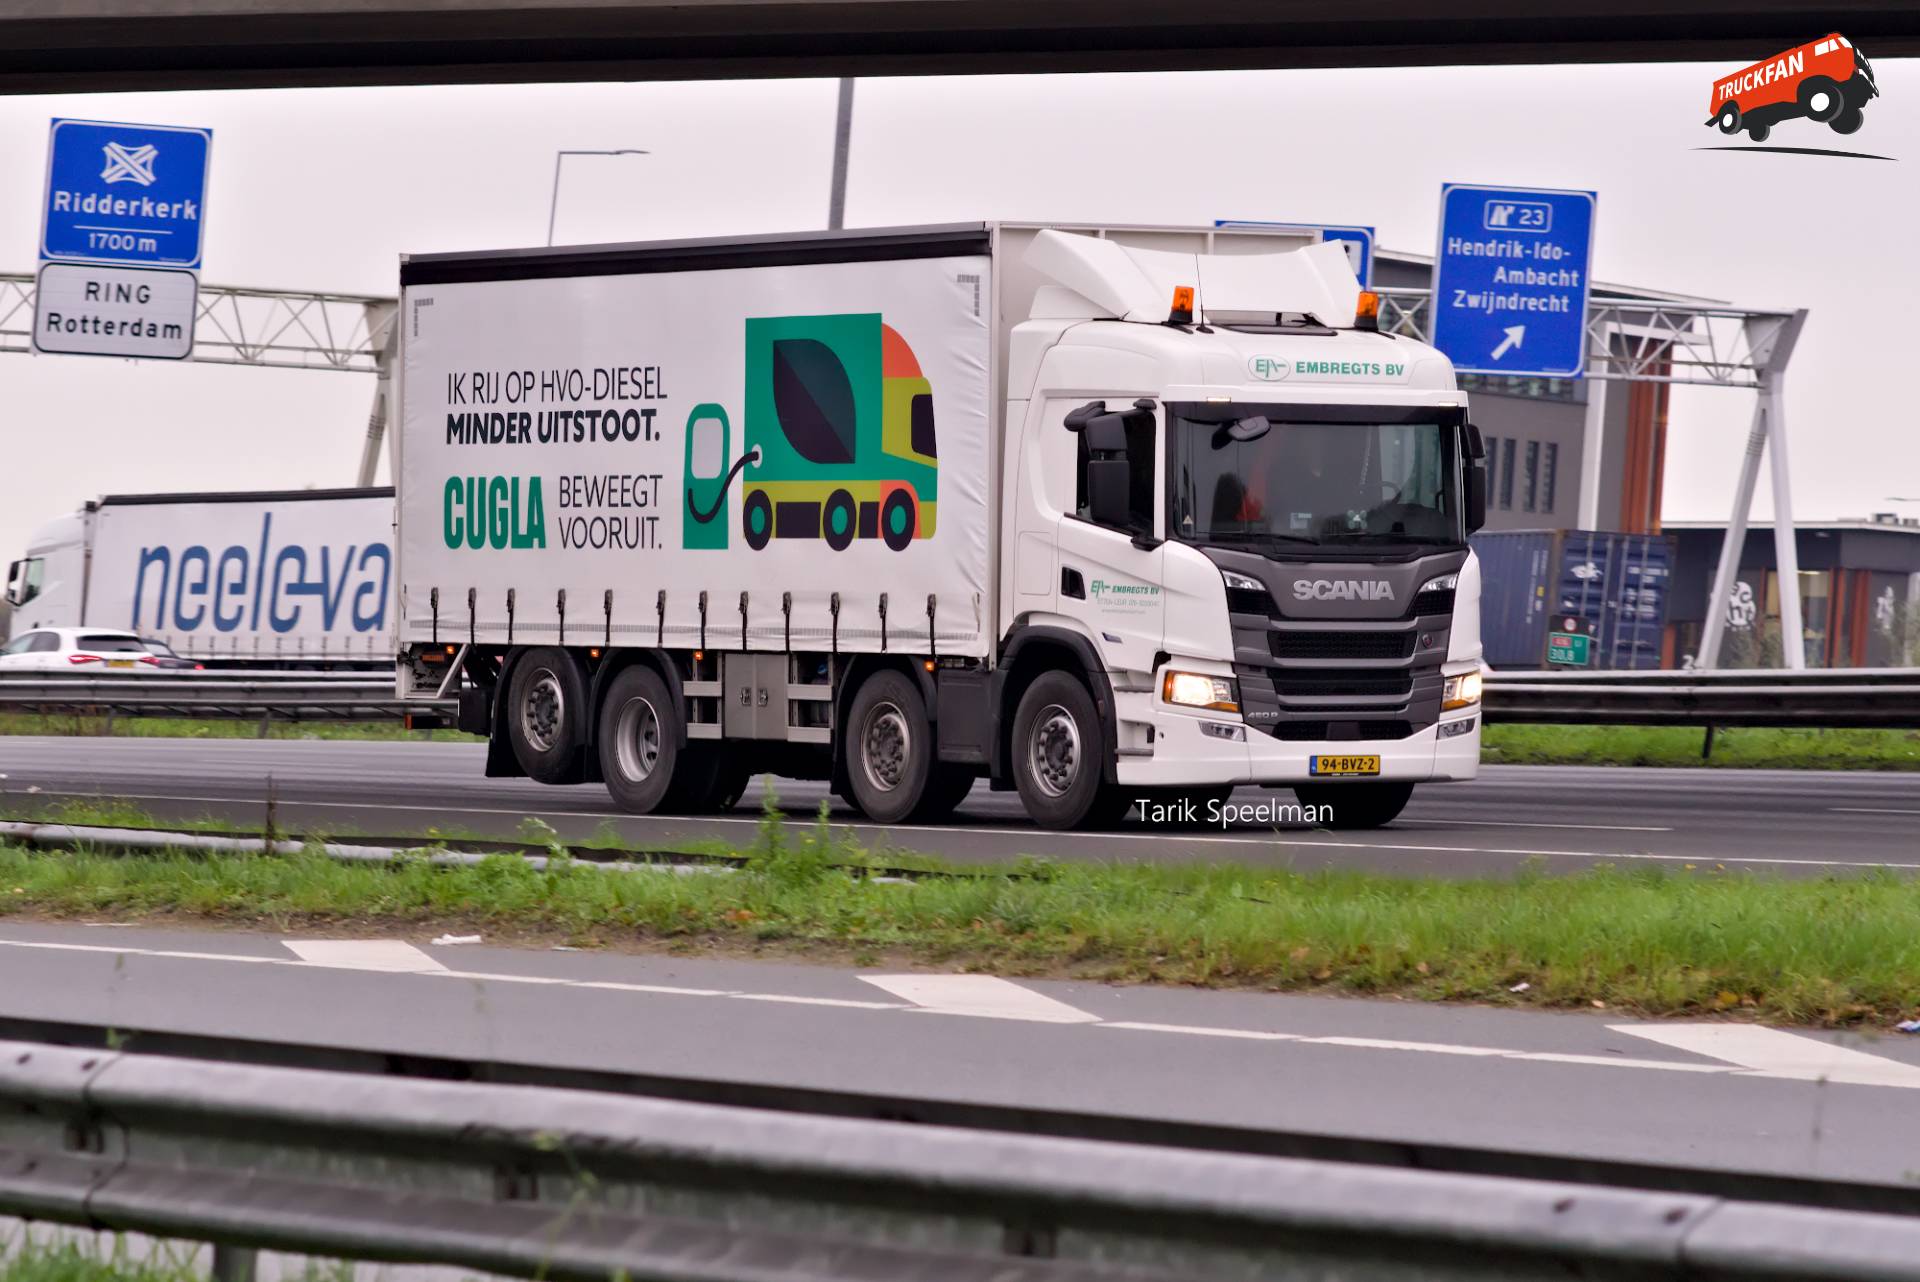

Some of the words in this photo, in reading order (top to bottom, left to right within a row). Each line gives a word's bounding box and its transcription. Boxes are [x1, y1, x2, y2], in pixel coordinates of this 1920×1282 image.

[53, 191, 198, 220] Ridderkerk
[1519, 209, 1545, 226] 23
[89, 232, 134, 251] 1700
[137, 237, 157, 253] m
[1447, 237, 1571, 260] Hendrik-Ido-
[1493, 266, 1579, 287] Ambacht
[85, 281, 152, 304] RING
[1453, 290, 1570, 314] Zwijndrecht
[46, 312, 183, 340] Rotterdam
[1296, 361, 1381, 376] EMBREGTS
[1385, 363, 1405, 376] BV
[448, 373, 466, 404] IK
[472, 372, 499, 404] RIJ
[505, 371, 535, 403] OP
[541, 366, 667, 402] HVO-DIESEL
[446, 412, 531, 444] MINDER
[537, 408, 660, 443] UITSTOOT.
[559, 475, 663, 508] BEWEEGT
[444, 476, 546, 549] CUGLA
[559, 516, 662, 549] VOORUIT.
[1112, 585, 1149, 594] EMBREGTS
[1293, 579, 1395, 601] SCANIA
[1322, 758, 1375, 770] 94-BVZ-2
